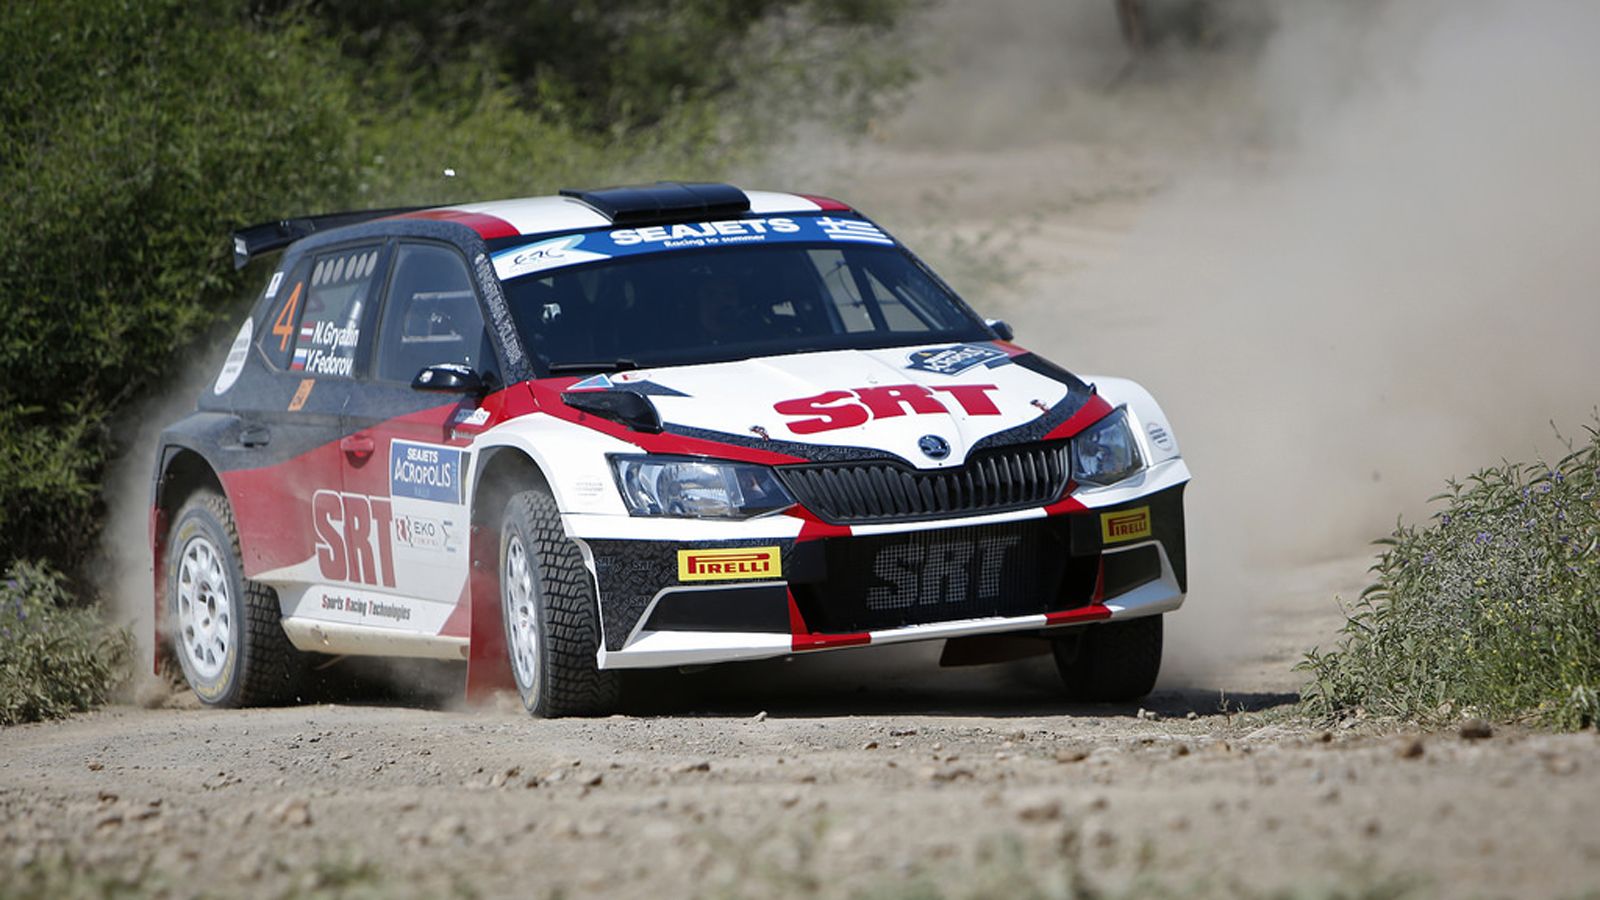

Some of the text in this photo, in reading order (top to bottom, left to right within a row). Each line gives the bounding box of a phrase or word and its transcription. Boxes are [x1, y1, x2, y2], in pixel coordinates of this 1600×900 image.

[609, 217, 801, 246] SEAJETS
[663, 234, 765, 248] Racing to summer
[272, 281, 303, 352] 4
[305, 347, 354, 377] Y.Fedorov
[772, 383, 1003, 435] SRT
[407, 447, 439, 464] SEAJETS
[394, 456, 451, 488] ACROPOLIS
[312, 489, 397, 589] SRT
[413, 521, 436, 538] EKO
[1107, 511, 1148, 538] PIRELLI
[687, 552, 771, 575] PIRELLI
[866, 535, 1022, 611] SRT
[322, 594, 411, 622] Sports Racing Technologies
